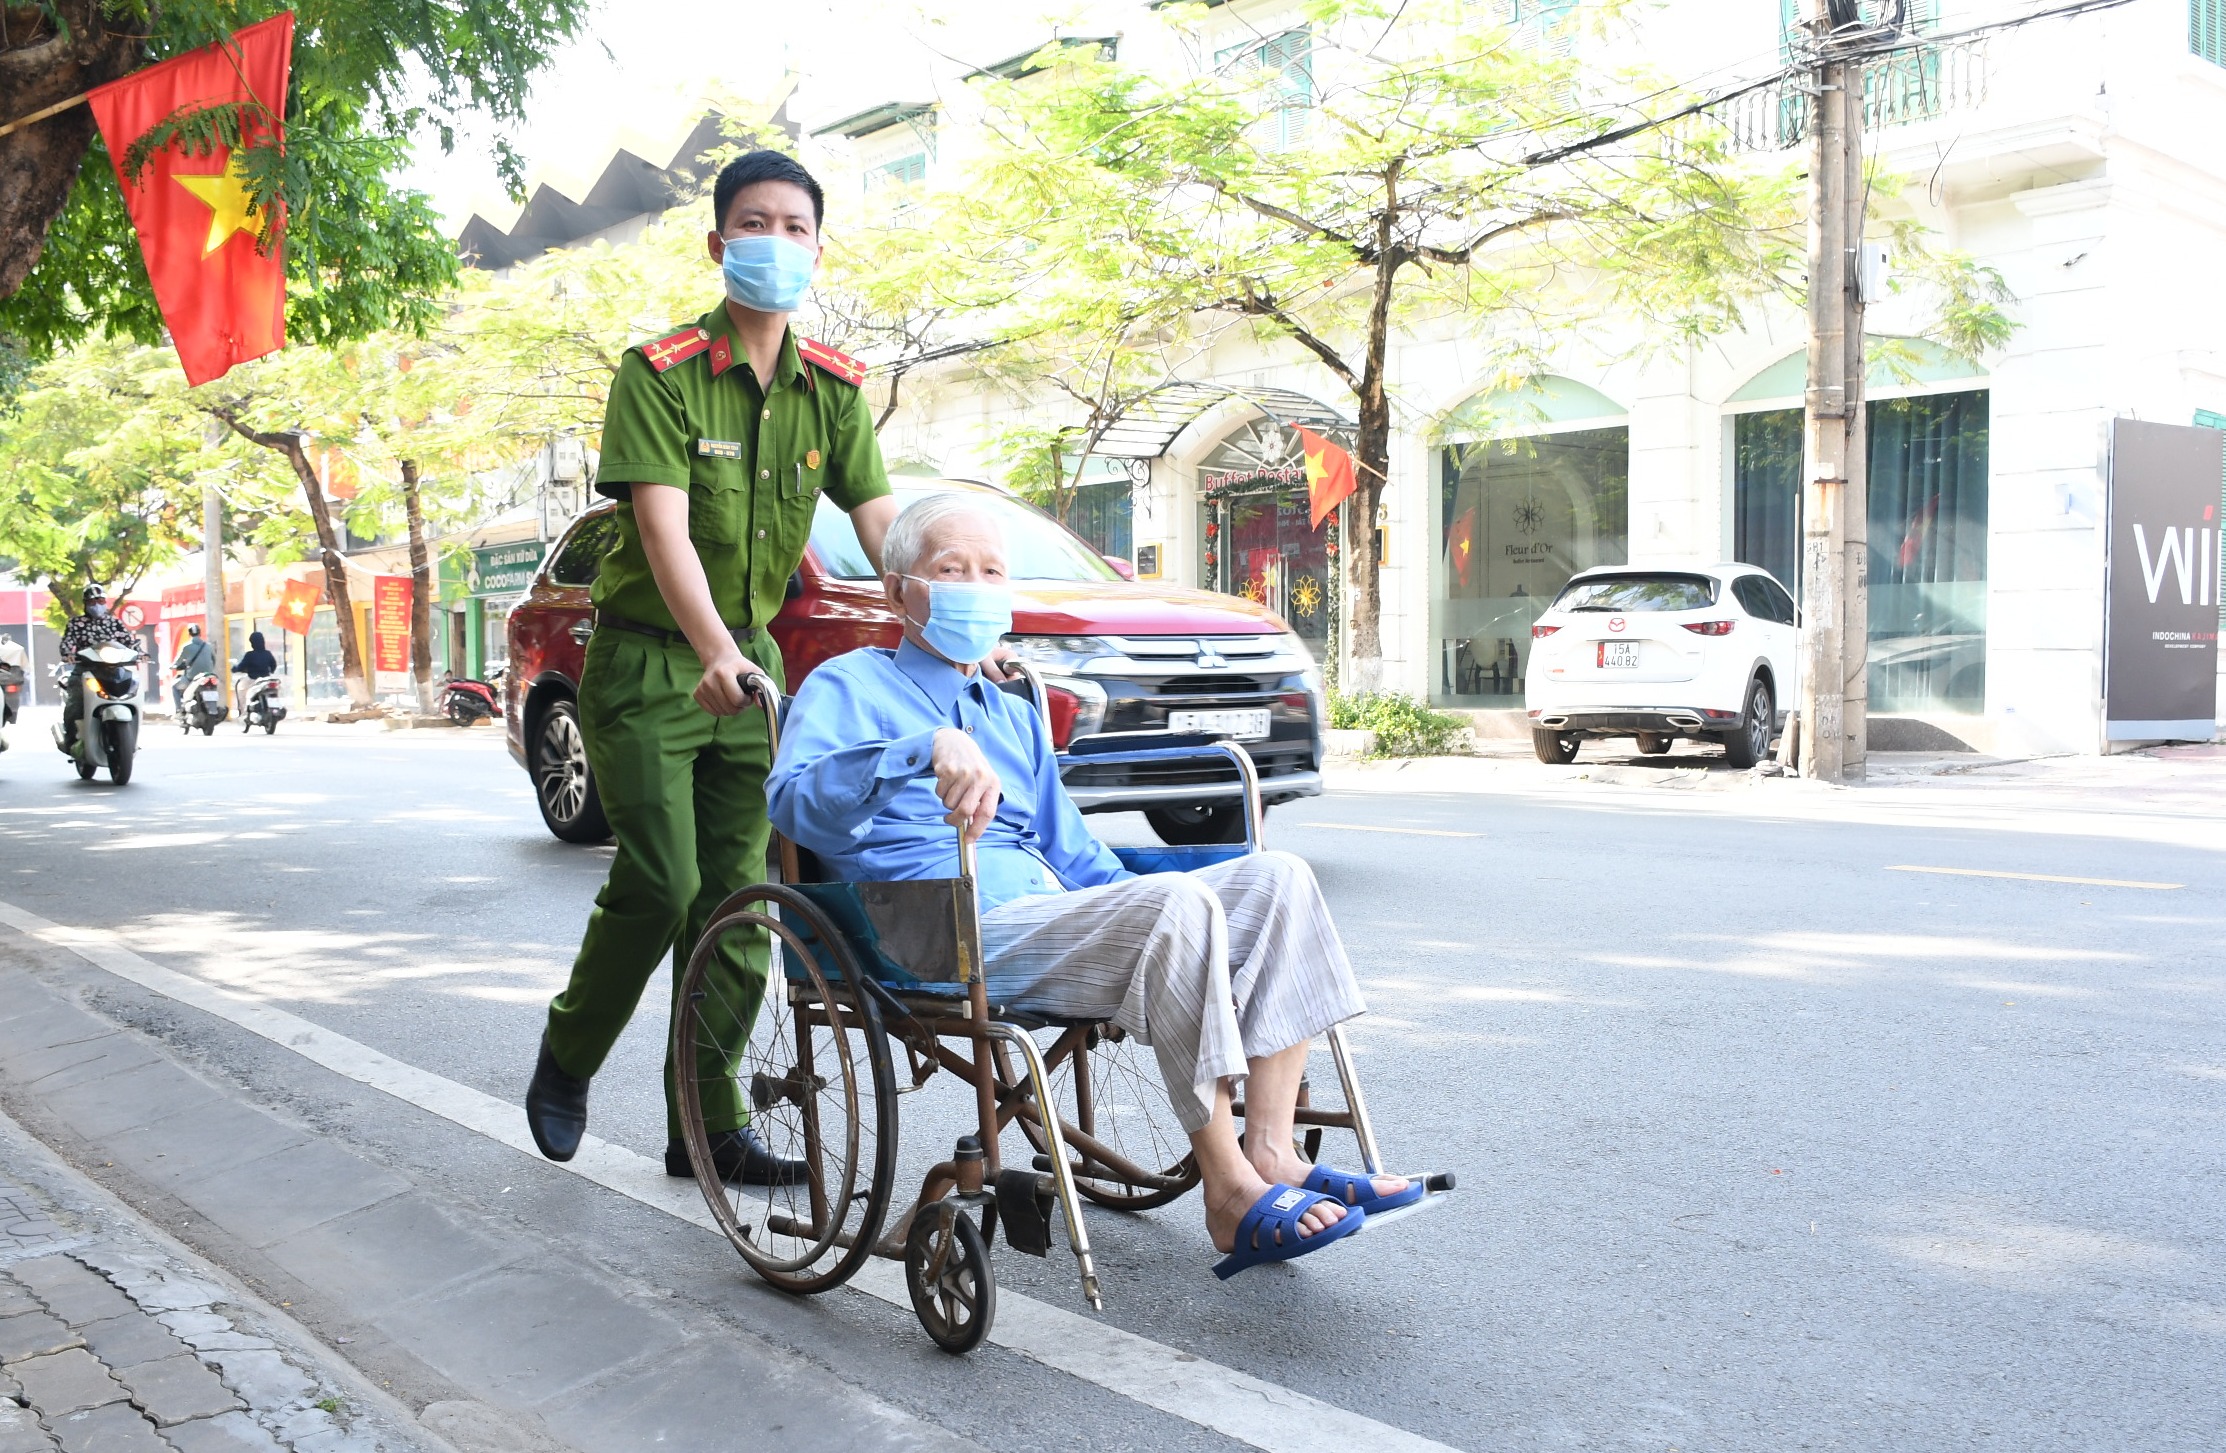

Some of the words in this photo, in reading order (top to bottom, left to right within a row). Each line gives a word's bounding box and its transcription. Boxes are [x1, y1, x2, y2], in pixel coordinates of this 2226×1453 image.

[1205, 470, 1253, 492] Buffet
[1505, 544, 1529, 555] Fleur
[1531, 542, 1553, 554] d'Or
[2152, 631, 2190, 641] INDOCHINA
[1614, 644, 1630, 655] 15A
